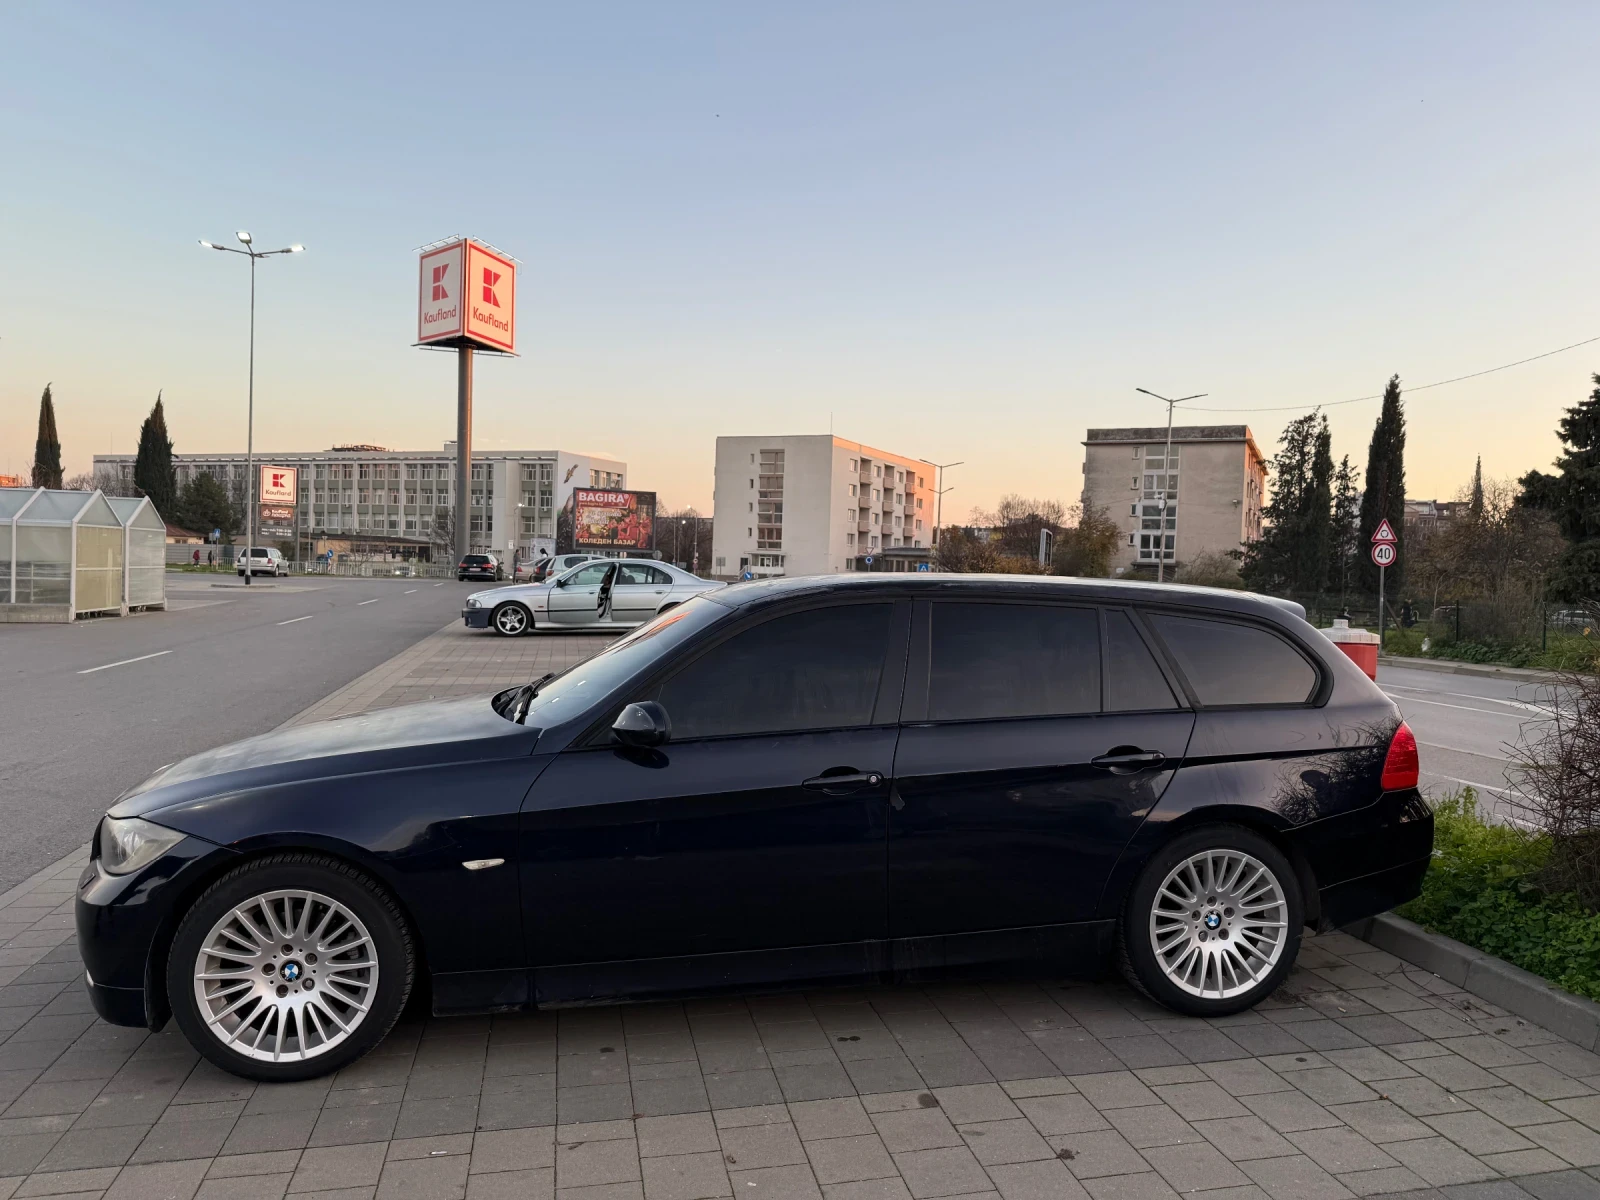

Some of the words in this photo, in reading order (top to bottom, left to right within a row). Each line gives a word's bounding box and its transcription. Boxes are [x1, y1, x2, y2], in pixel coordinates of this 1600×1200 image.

[424, 305, 456, 324] Kaufland
[473, 306, 508, 331] Kaufland
[1377, 548, 1390, 559] 40
